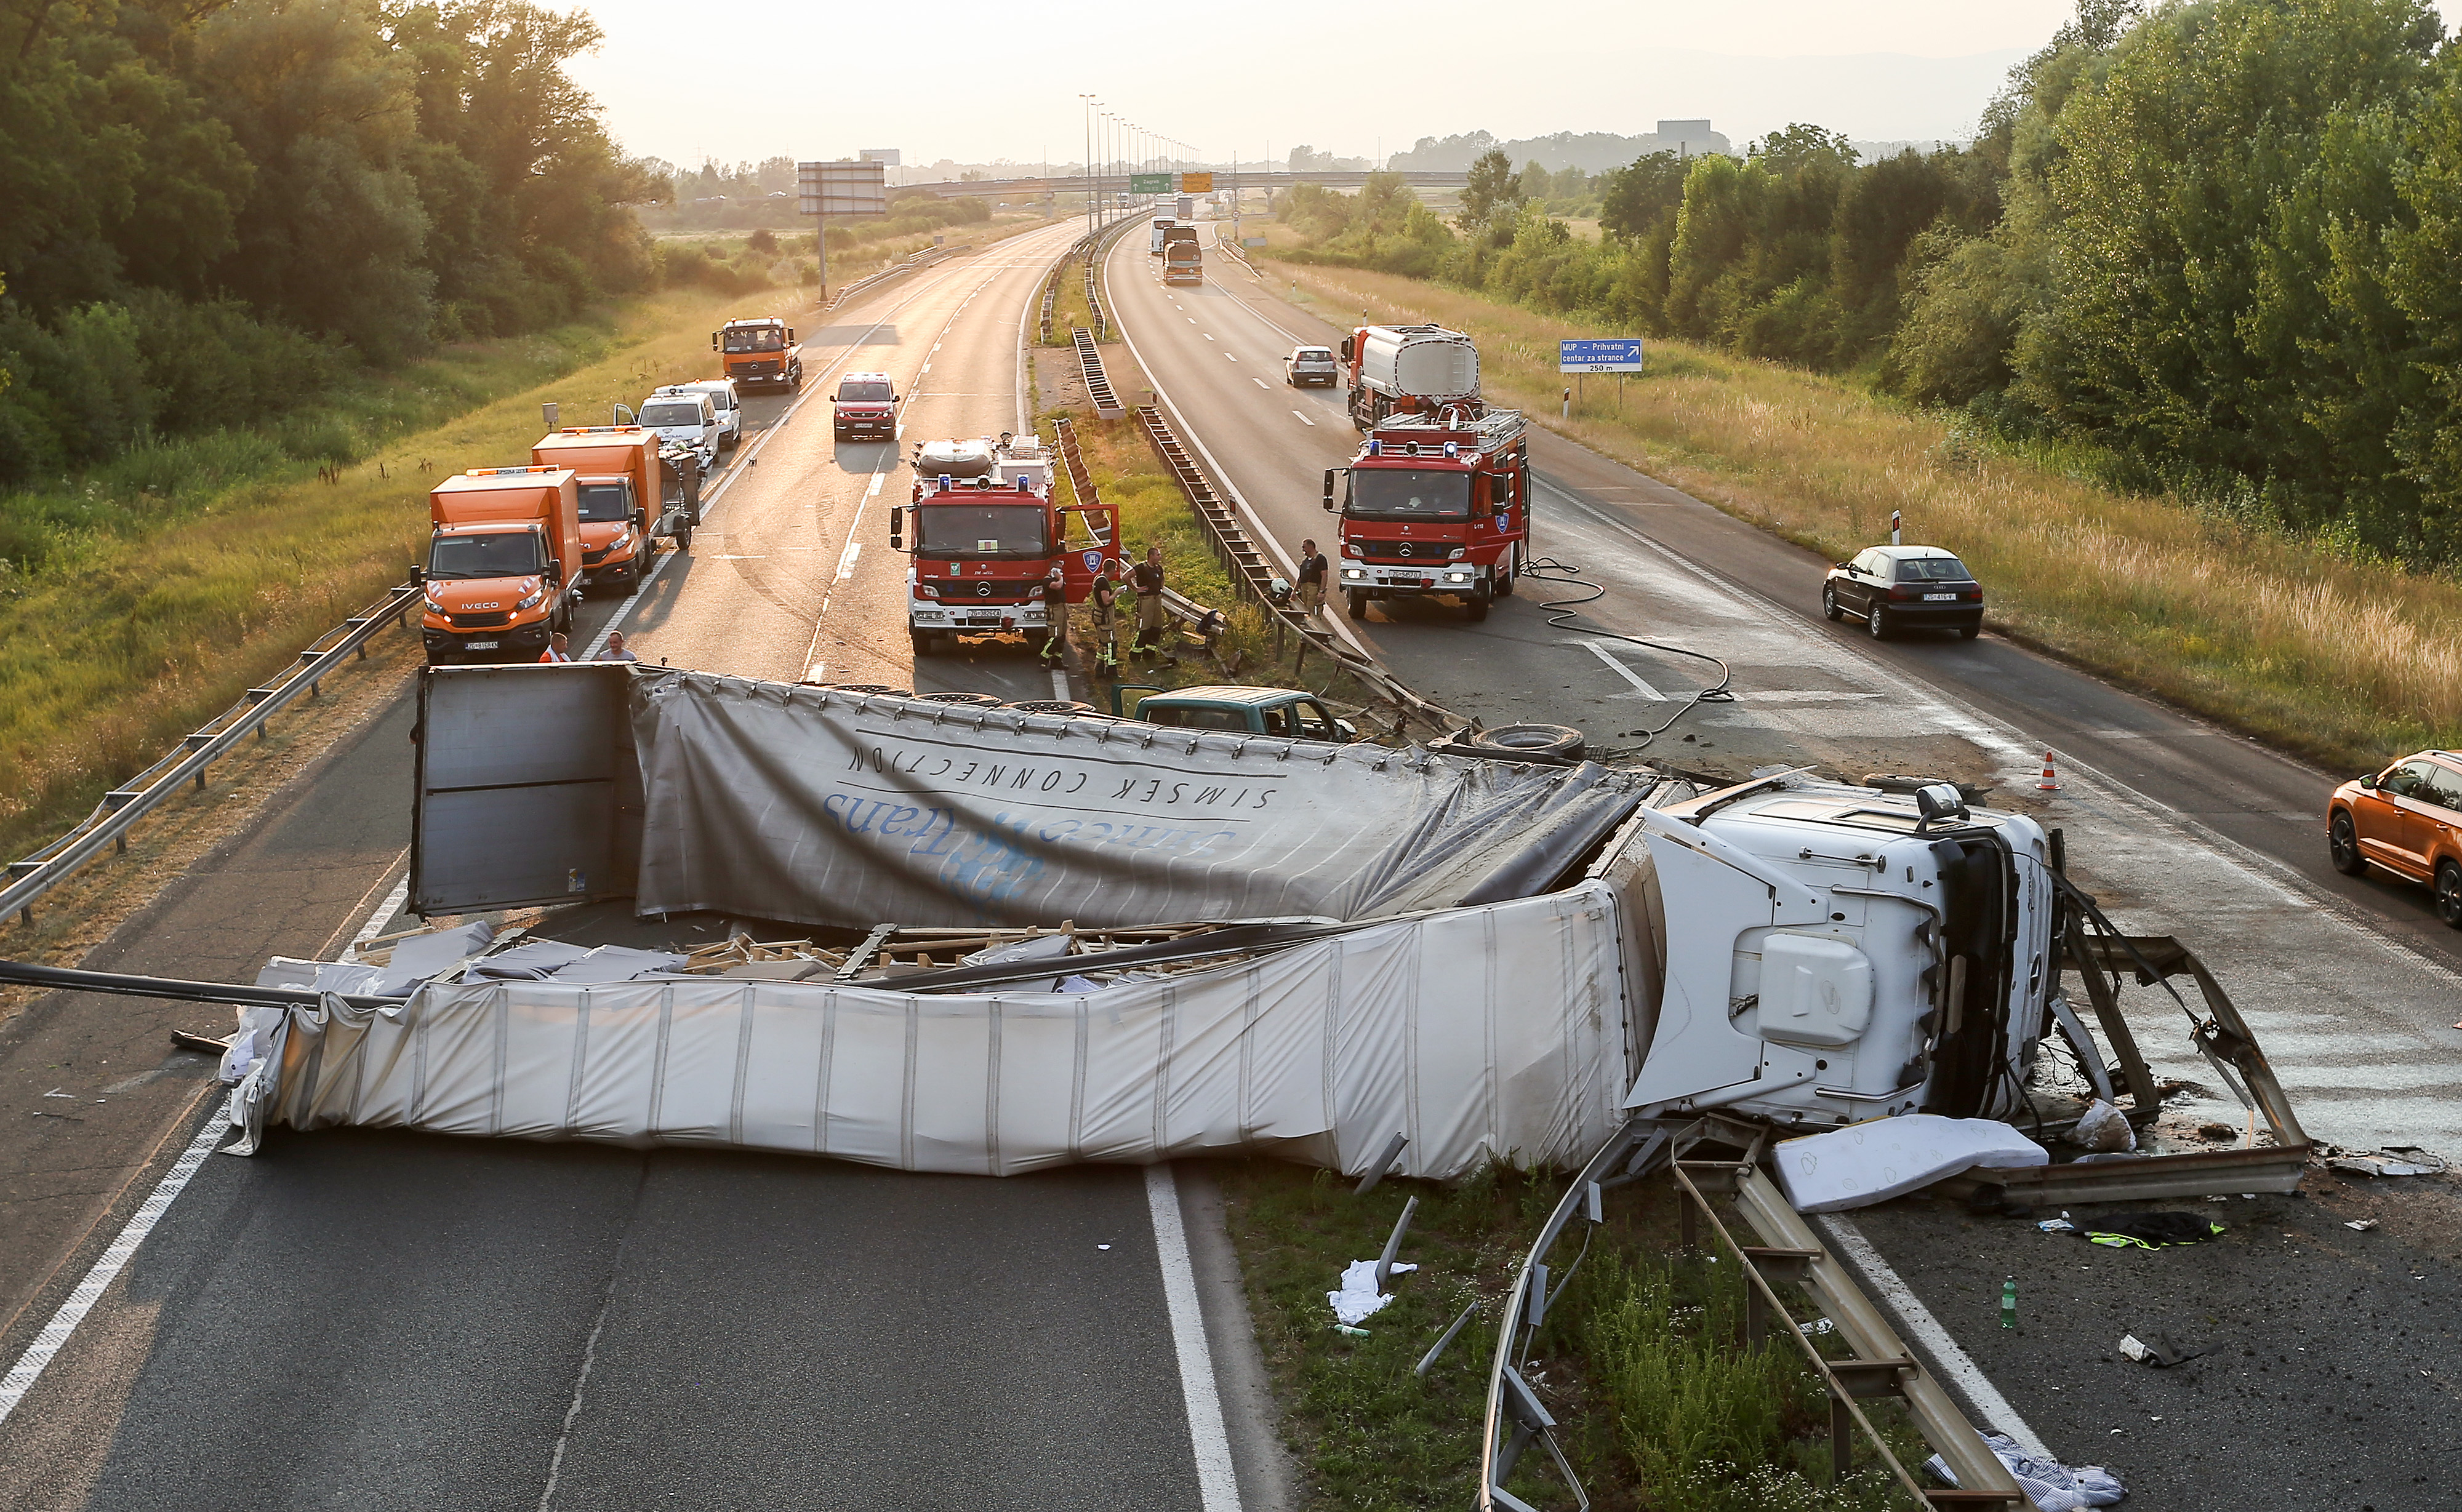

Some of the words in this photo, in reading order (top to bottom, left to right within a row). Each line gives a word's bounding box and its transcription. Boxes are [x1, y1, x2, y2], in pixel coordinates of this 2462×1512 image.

[1592, 343, 1624, 351] Prihvatni
[848, 746, 1088, 793] CONNECTION
[1110, 778, 1277, 809] SIMSEK
[823, 793, 955, 856] Trans
